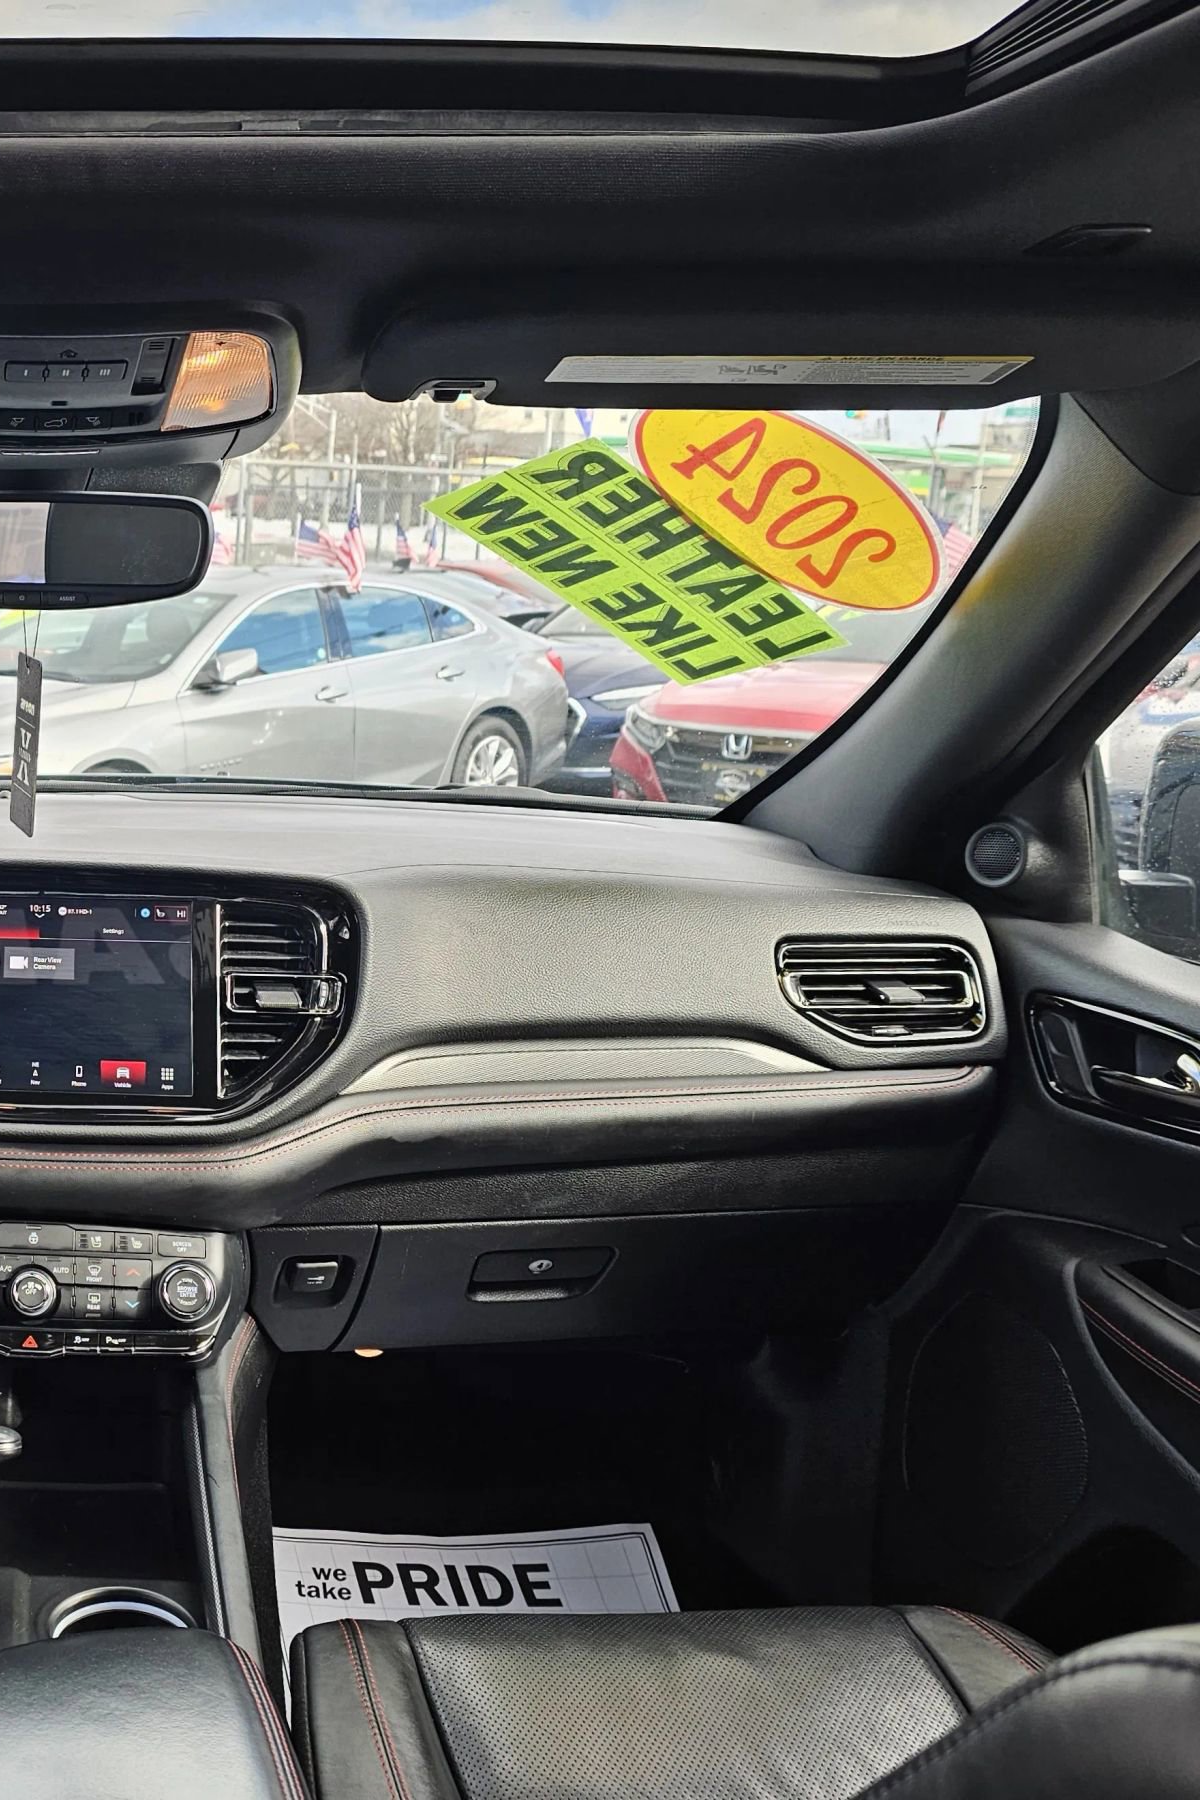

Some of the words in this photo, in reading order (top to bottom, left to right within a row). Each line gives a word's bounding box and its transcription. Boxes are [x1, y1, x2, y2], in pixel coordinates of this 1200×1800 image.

[29, 904, 51, 912] 10:15
[176, 910, 186, 918] HI
[311, 1566, 347, 1581] we
[295, 1580, 352, 1601] take
[352, 1560, 563, 1608] PRIDE
